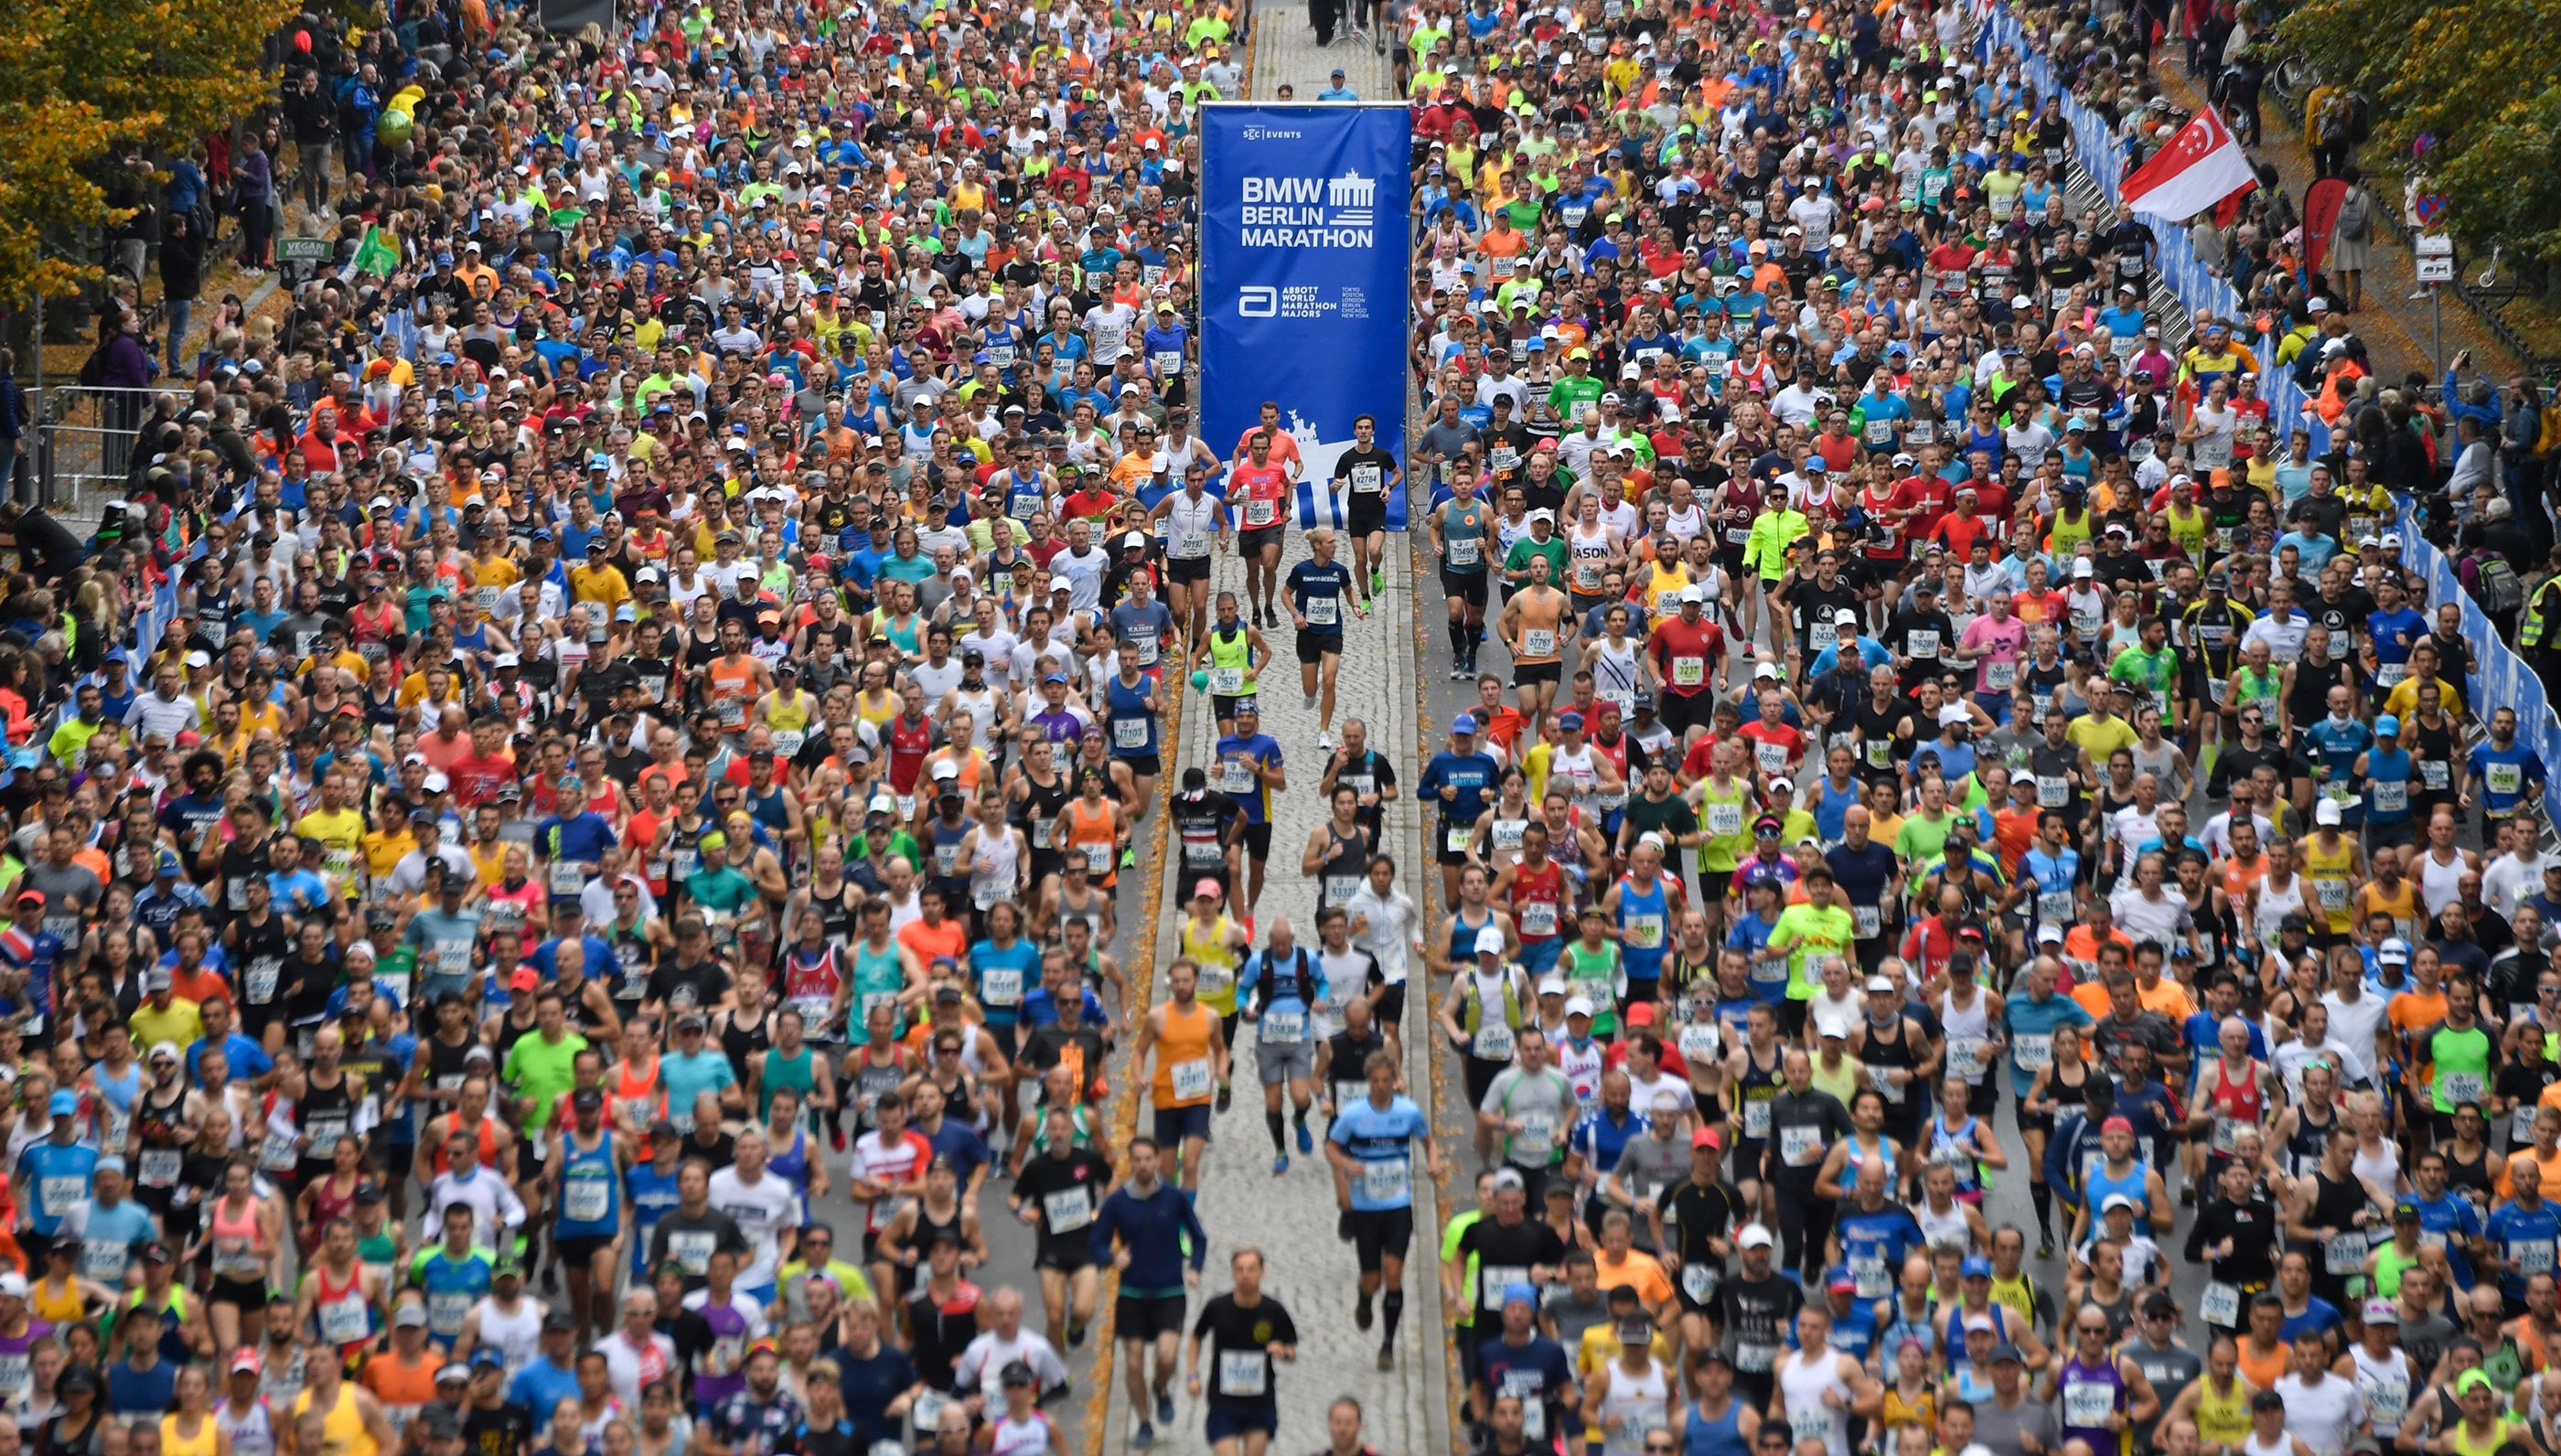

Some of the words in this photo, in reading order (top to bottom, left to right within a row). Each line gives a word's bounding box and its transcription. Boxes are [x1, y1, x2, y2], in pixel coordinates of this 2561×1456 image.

[1243, 129, 1260, 140] SCC
[1266, 131, 1302, 139] EVENTS
[1242, 177, 1323, 203] BMW
[1242, 207, 1323, 226] BERLIN
[1242, 229, 1373, 248] MARATHON
[287, 241, 325, 252] VEGAN
[1282, 286, 1318, 294] ABBOTT
[1281, 294, 1315, 302] WORLD
[1281, 302, 1336, 310] MARATHON
[1281, 309, 1321, 318] MAJORS
[1100, 329, 1119, 338] 27692
[1356, 476, 1377, 484] 42784
[1250, 508, 1270, 517] 70031
[1183, 540, 1203, 548] 20193
[1453, 548, 1474, 556] 70495
[1311, 606, 1334, 616] 22890
[1528, 638, 1550, 648] 57761
[1678, 665, 1698, 675] 3237
[1120, 728, 1142, 739] 17103
